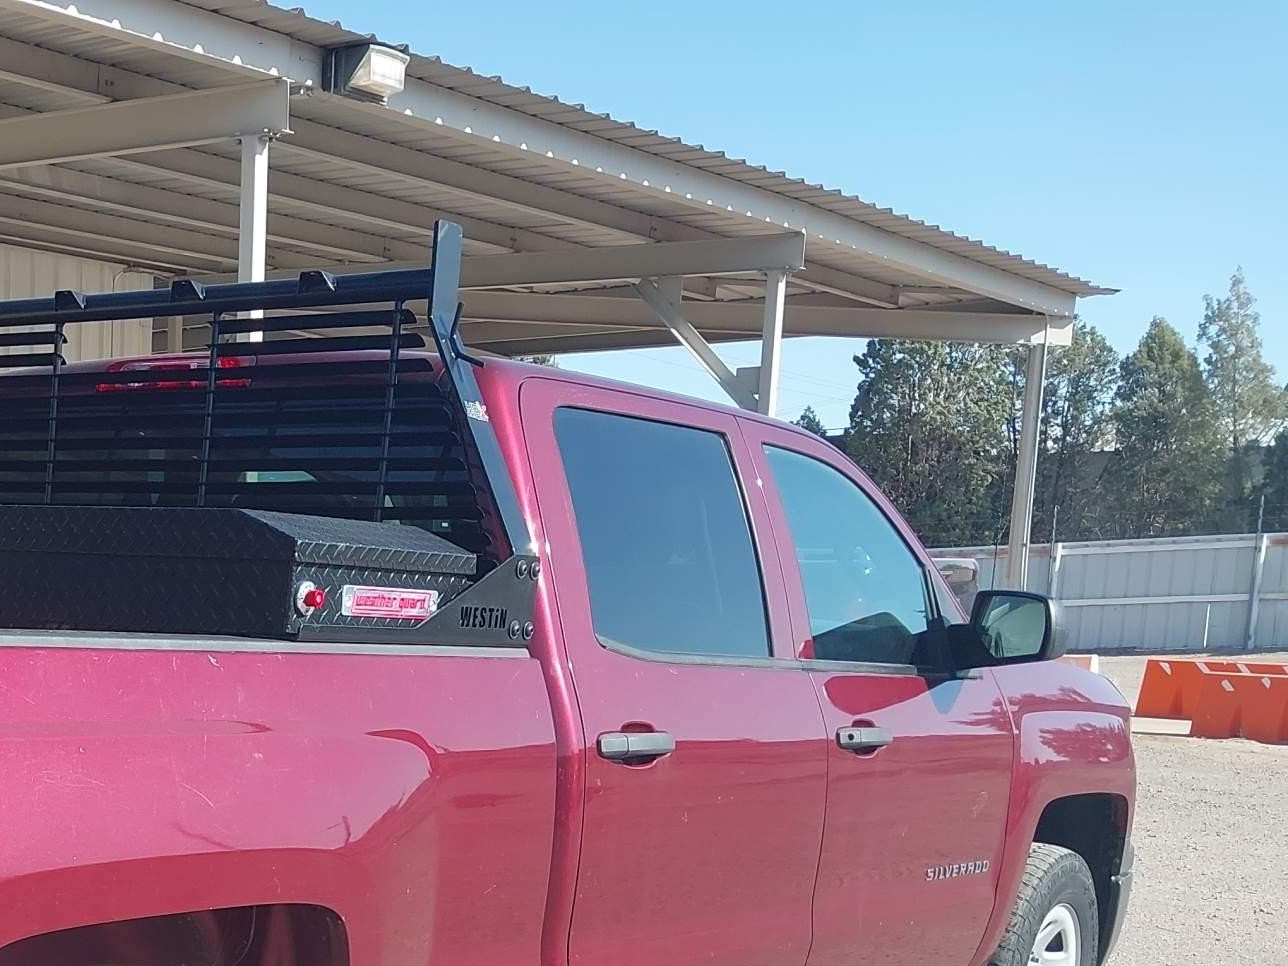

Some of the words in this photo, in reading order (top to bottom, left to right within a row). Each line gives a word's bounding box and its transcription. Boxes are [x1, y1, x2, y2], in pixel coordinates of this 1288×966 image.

[355, 594, 397, 609] weather
[398, 595, 427, 611] guard
[925, 860, 990, 881] SILVERADO
